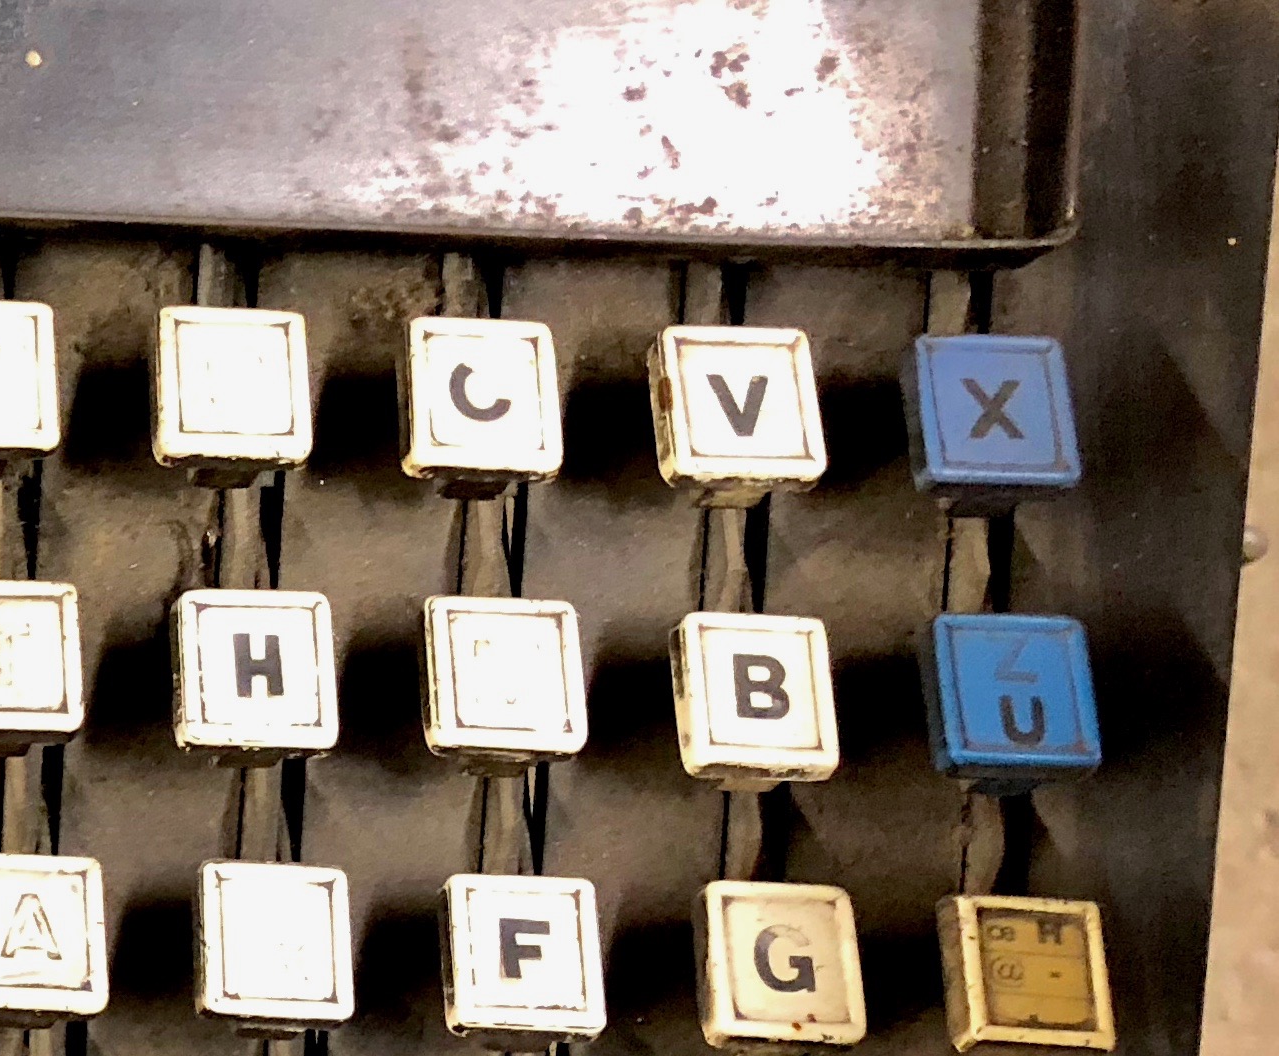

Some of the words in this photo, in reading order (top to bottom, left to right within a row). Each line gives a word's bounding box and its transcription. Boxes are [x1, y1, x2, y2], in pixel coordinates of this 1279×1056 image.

[449, 362, 511, 422] C
[705, 373, 769, 437] V
[962, 377, 1025, 440] X
[233, 631, 285, 698] H
[731, 652, 791, 721] B
[998, 692, 1046, 747] U
[0, 893, 63, 960] A
[498, 917, 552, 980] F
[752, 923, 818, 995] G
